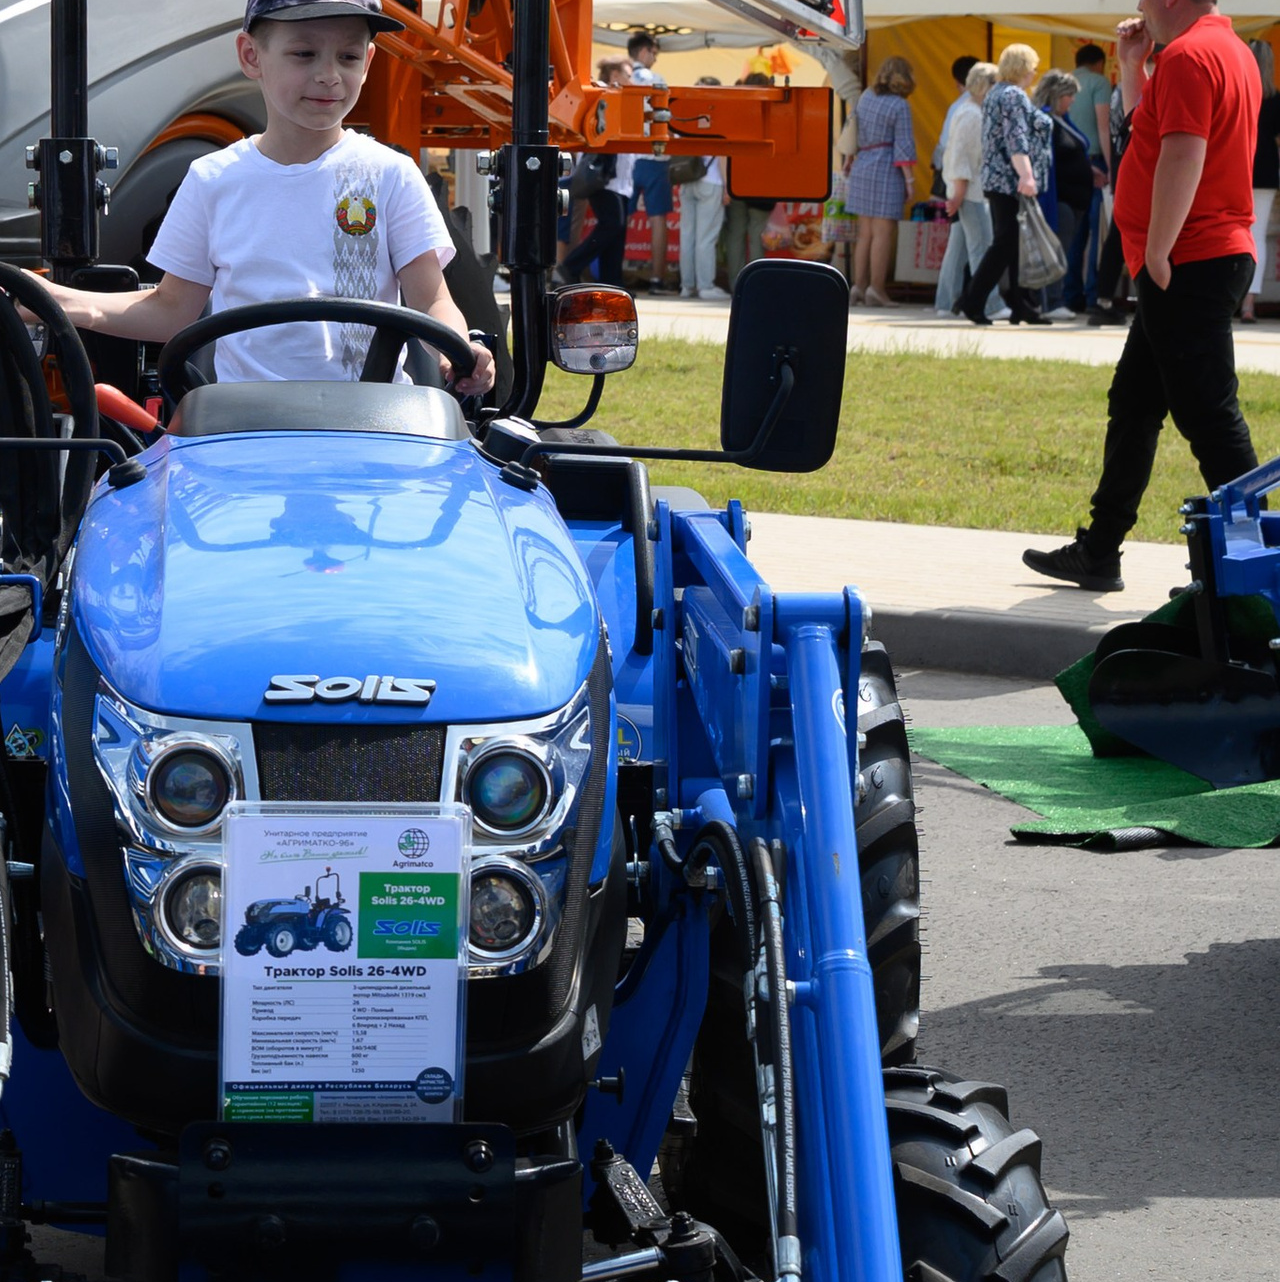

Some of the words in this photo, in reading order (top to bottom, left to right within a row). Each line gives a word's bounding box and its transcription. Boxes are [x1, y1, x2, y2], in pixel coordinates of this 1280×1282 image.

[263, 830, 310, 838] Унитарное
[311, 830, 368, 838] предприятие
[276, 839, 355, 847] «АГРИМАТКО-96»
[392, 860, 434, 869] Agrimatco
[383, 883, 431, 894] Трактор
[371, 896, 398, 905] Solis
[399, 896, 446, 905] 26-4WD
[263, 965, 326, 978] Трактор
[329, 965, 364, 977] Solis
[367, 965, 427, 977] 26-4WD
[777, 977, 785, 990] 100
[785, 1117, 793, 1135] MAX
[786, 1149, 794, 1173] FLAME
[786, 1174, 795, 1212] RESISTANT
